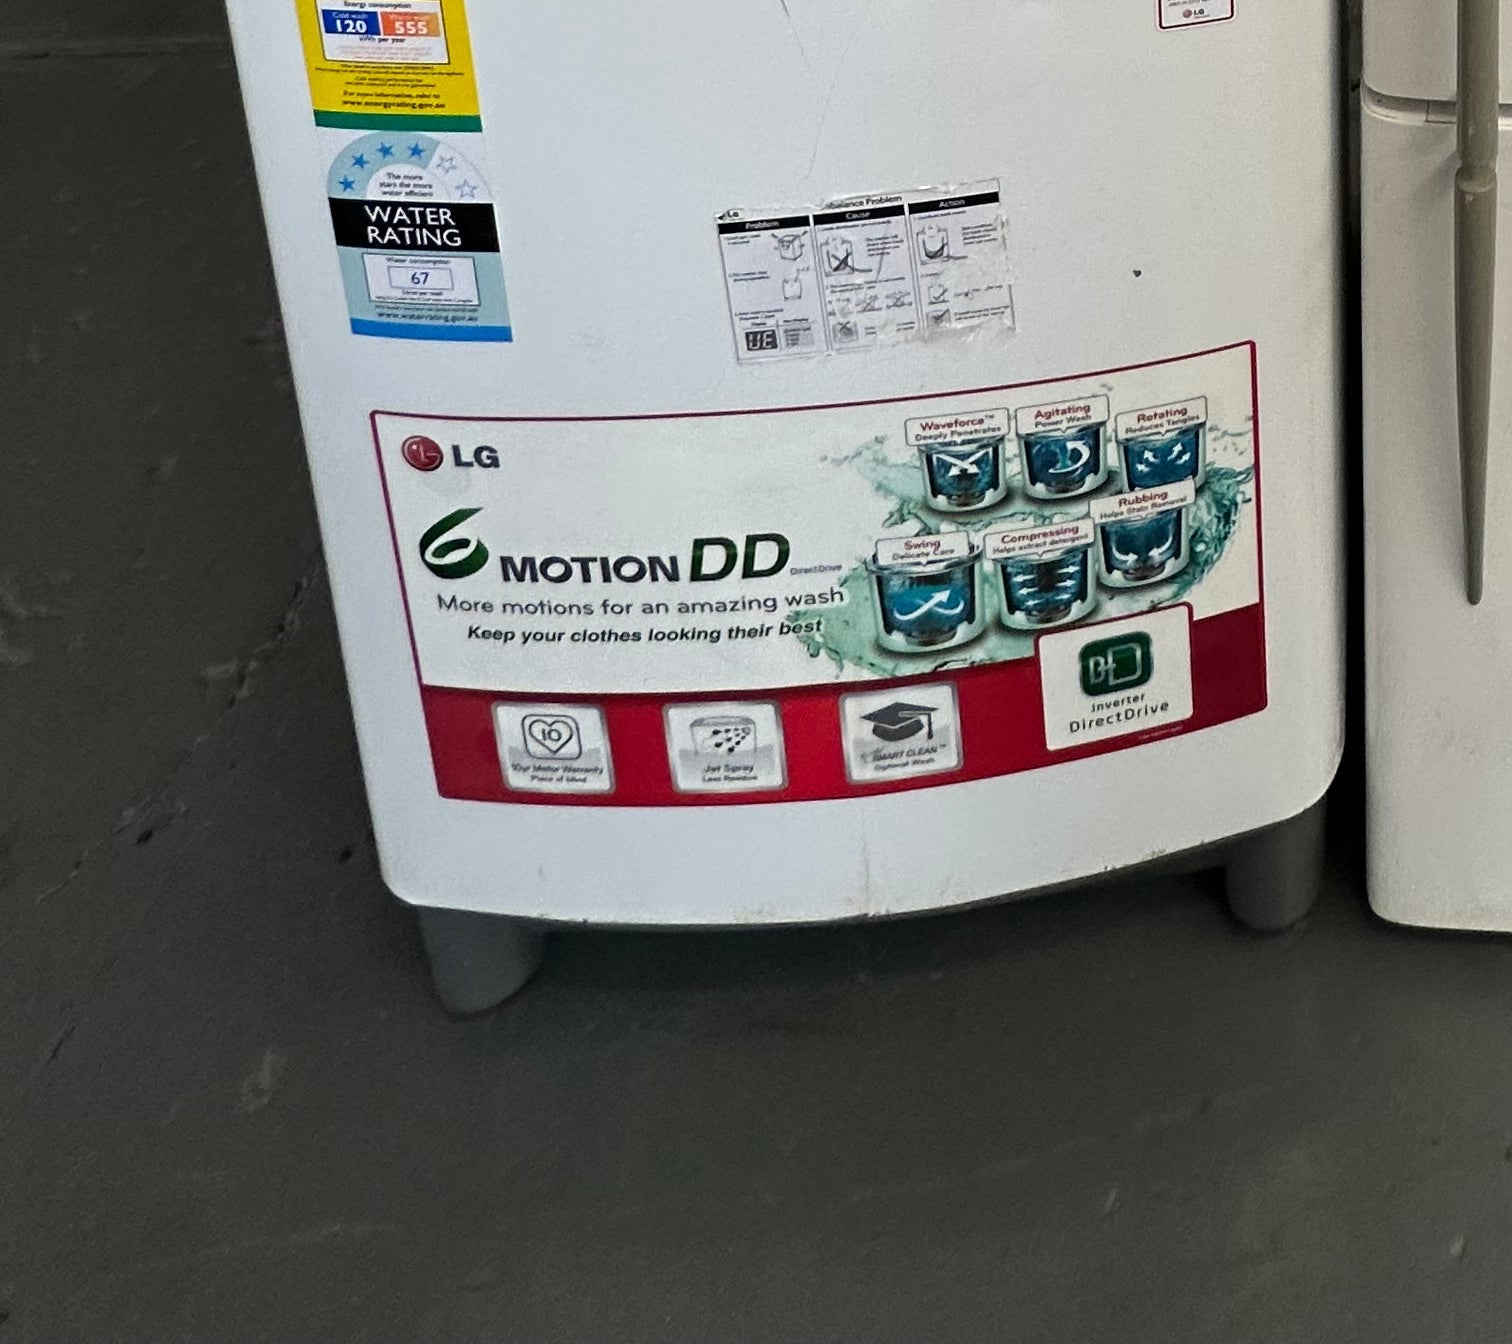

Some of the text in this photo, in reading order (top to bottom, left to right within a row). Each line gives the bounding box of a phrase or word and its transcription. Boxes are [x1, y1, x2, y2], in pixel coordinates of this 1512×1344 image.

[335, 19, 428, 35] 120 555
[386, 172, 401, 180] The
[363, 205, 456, 226] WATER
[367, 225, 462, 247] RATING
[411, 271, 430, 285] 67
[1034, 403, 1091, 421] Agitating
[1136, 406, 1188, 424] Rotating
[451, 443, 501, 469] LG
[1118, 490, 1169, 508] Rubbing
[1001, 524, 1080, 544] Compressing
[903, 539, 941, 551] Swing
[500, 555, 681, 583] MOTION
[689, 533, 791, 583] DD
[437, 587, 844, 616] More motions for an amazing wash
[467, 619, 823, 645] Keep your clothes looking their best
